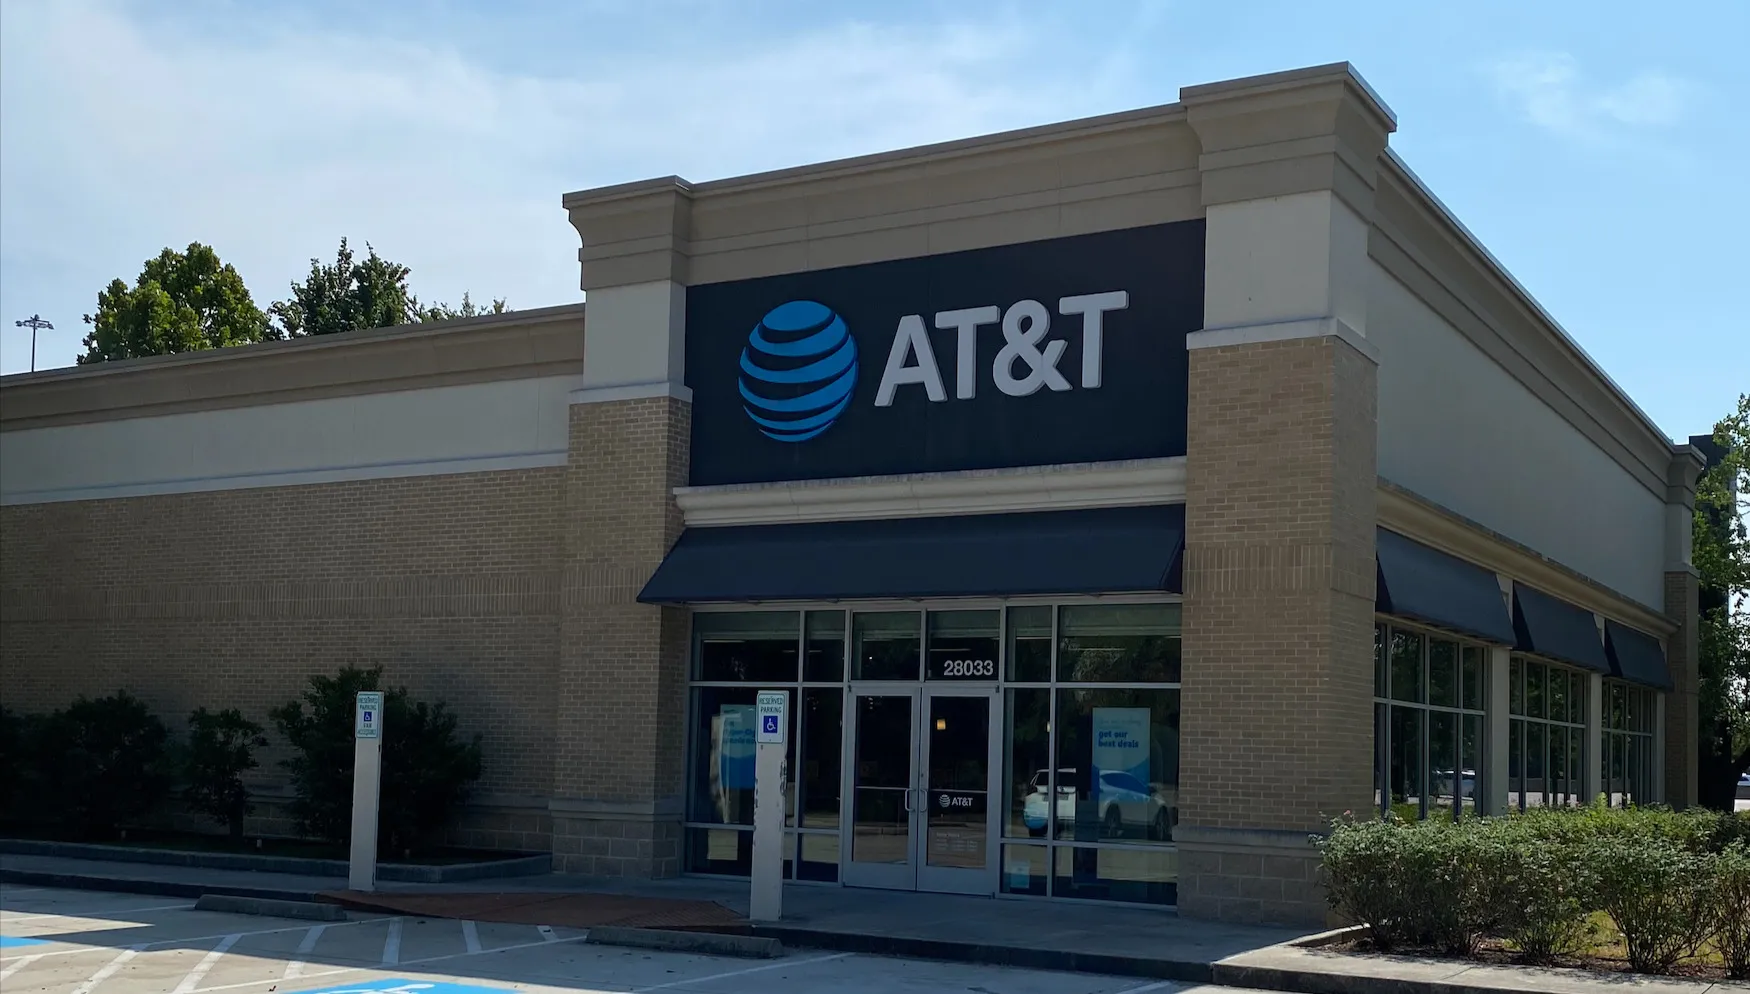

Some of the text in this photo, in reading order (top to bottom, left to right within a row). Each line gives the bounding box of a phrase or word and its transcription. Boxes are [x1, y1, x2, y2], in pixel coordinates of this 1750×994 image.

[874, 290, 1130, 407] AT&T
[943, 659, 994, 676] 28033
[759, 697, 783, 705] RESERVED
[1098, 731, 1112, 739] get
[1098, 739, 1139, 748] best deals
[951, 797, 974, 807] AT&T
